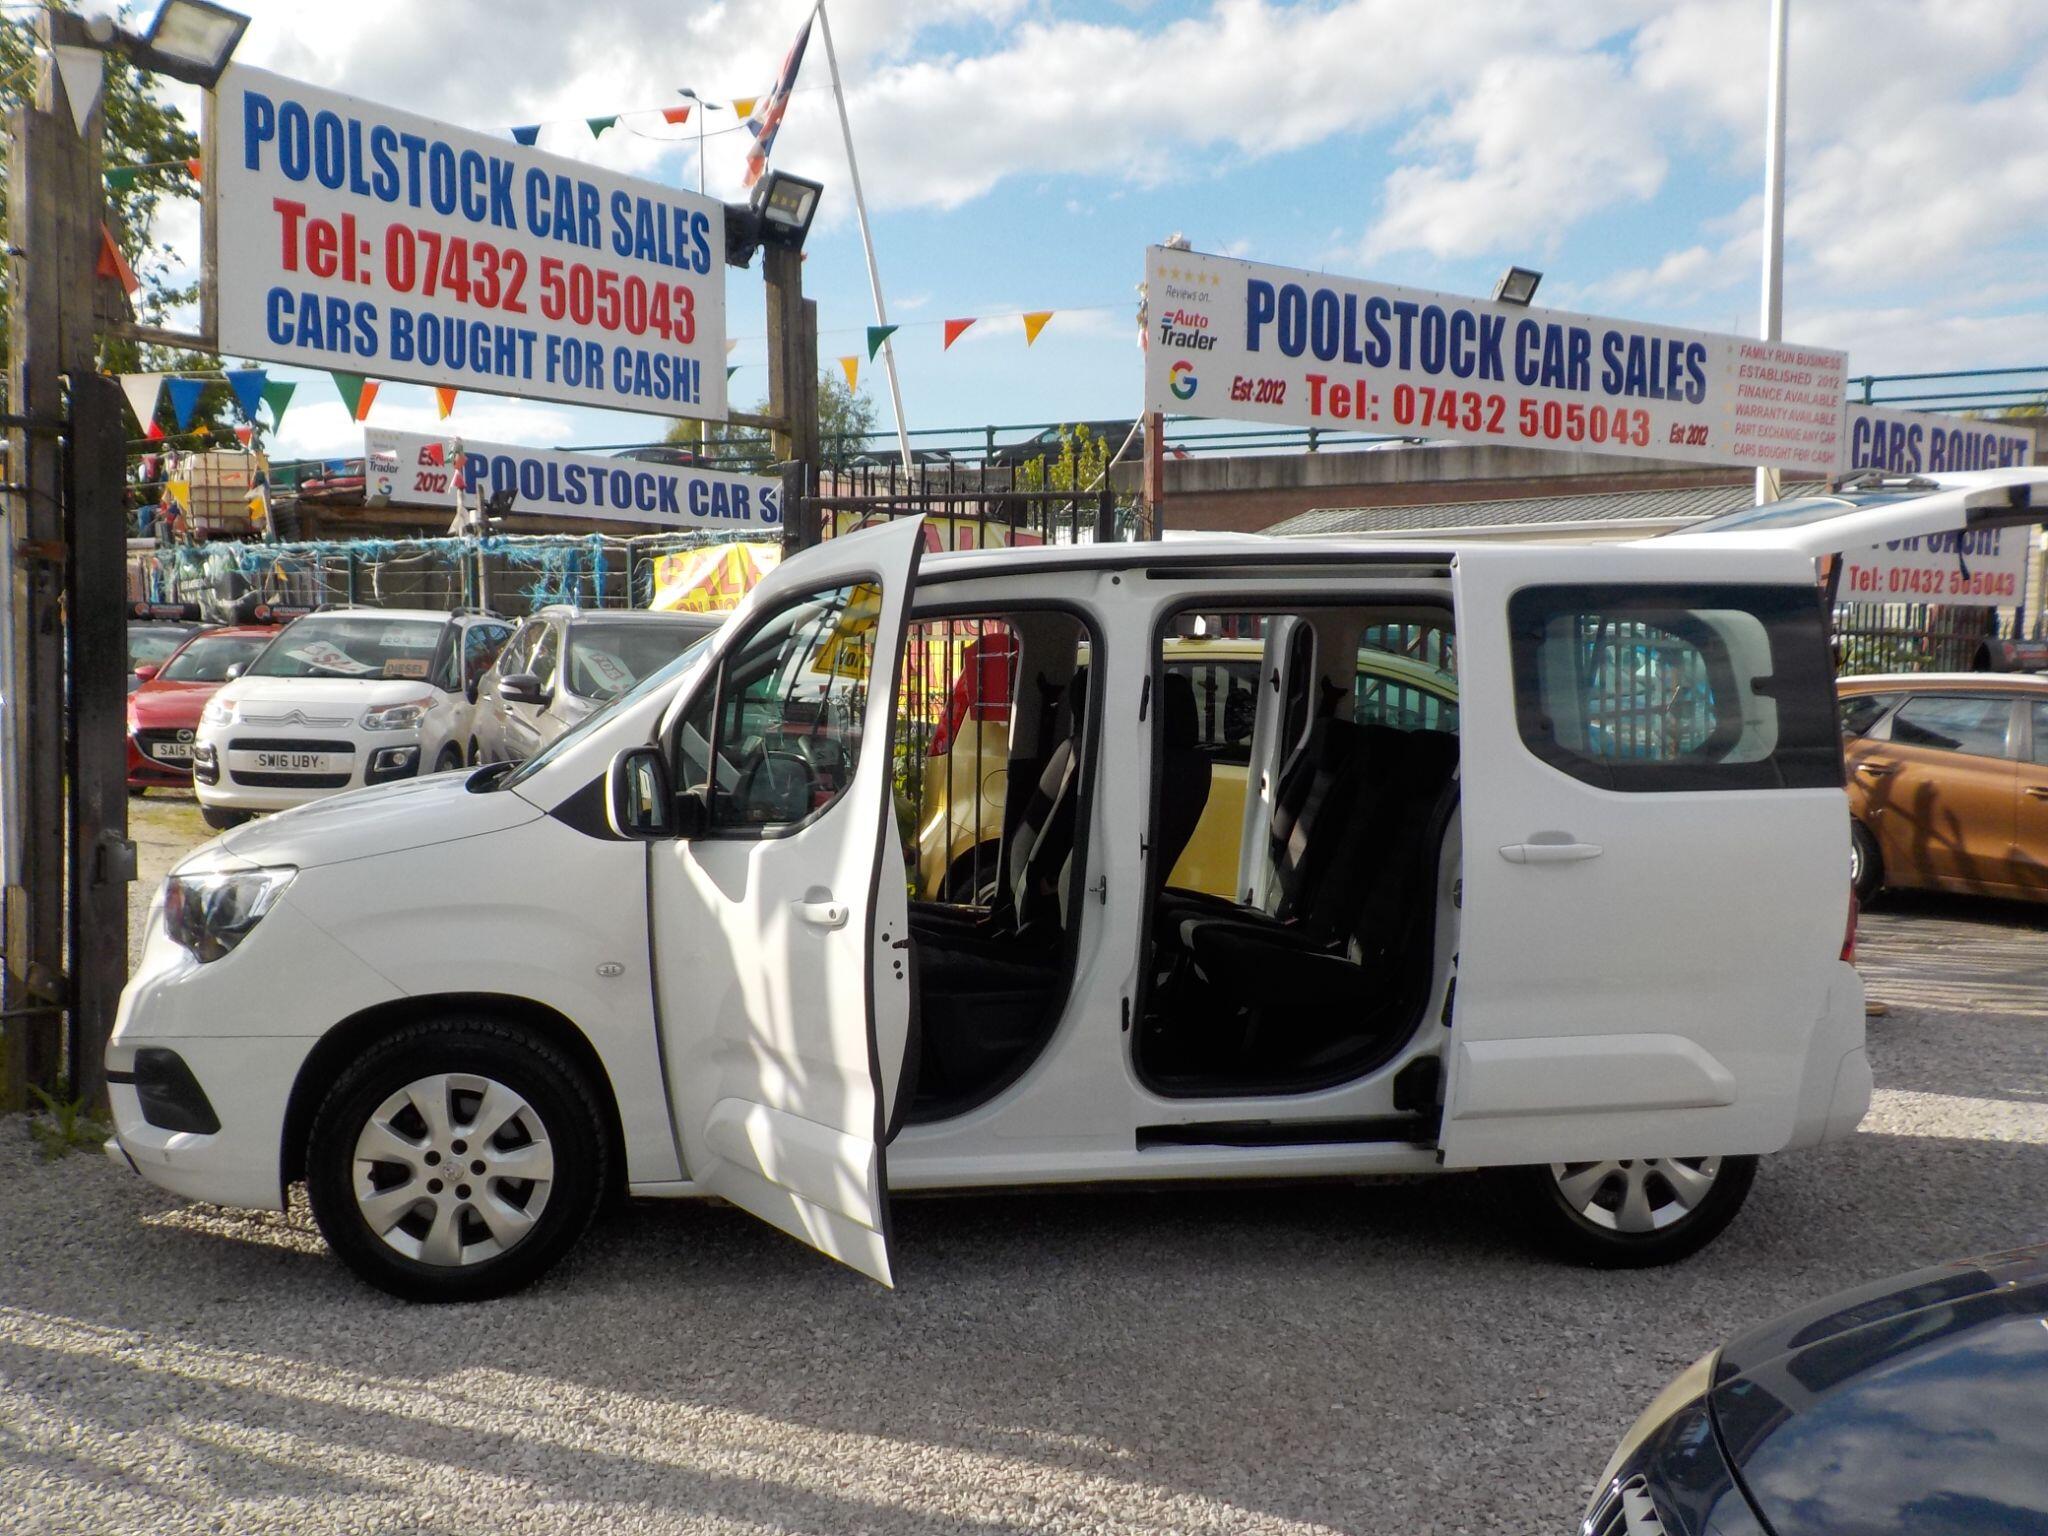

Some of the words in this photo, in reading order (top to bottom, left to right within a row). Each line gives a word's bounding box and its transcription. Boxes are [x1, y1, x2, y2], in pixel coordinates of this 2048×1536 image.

[244, 90, 517, 230] POOLSTOCK
[525, 166, 601, 250] CAR
[611, 190, 711, 275] SALES
[273, 197, 371, 285] Tel:
[385, 222, 527, 313] 07432
[540, 255, 695, 345] 505043
[1166, 284, 1197, 301] Reviews
[1174, 309, 1209, 328] Auto
[267, 287, 378, 357] CARS
[390, 307, 537, 380] BOUGHT
[546, 334, 604, 390] FOR
[613, 346, 701, 405] CASH!
[1160, 324, 1217, 350] Trader
[1246, 278, 1506, 382] POOLSTOCK
[1515, 318, 1591, 392] CAR
[1602, 330, 1707, 405] SALES
[1740, 345, 1774, 360] FAMILY
[1775, 350, 1795, 364] RUN
[1796, 352, 1842, 370] BUSINESS
[1169, 360, 1198, 400] G
[1740, 364, 1812, 385] ESTABLISHED
[1817, 375, 1840, 389] 2012
[1230, 375, 1253, 402] Est
[1254, 378, 1287, 405] 2012
[1738, 384, 1784, 401] FINANCE
[1784, 390, 1838, 408] AVAILABLE
[1305, 373, 1379, 422] Tel:
[1393, 383, 1506, 435] 07432
[1519, 398, 1651, 447] 505043
[1736, 402, 1788, 419] WARRANTY
[1788, 409, 1837, 425] AVAILABLE
[1669, 422, 1685, 444] Est
[1685, 424, 1708, 446] 2012
[1735, 422, 1757, 435] PART
[1758, 424, 1801, 441] EXCHANGE
[1734, 442, 1757, 456] CARS
[1758, 445, 1793, 460] BOUGHT
[1852, 416, 1923, 474] CARS
[369, 460, 399, 474] Trader
[414, 472, 448, 494] 2012
[464, 452, 681, 514] POOLSTOCK
[688, 479, 750, 520] CAR
[1850, 565, 1883, 593] Tel:
[1888, 567, 1943, 595] 07432
[386, 663, 423, 674] DIESEL
[160, 744, 187, 756] SA15
[258, 754, 288, 768] SW16
[291, 755, 319, 768] UBY
